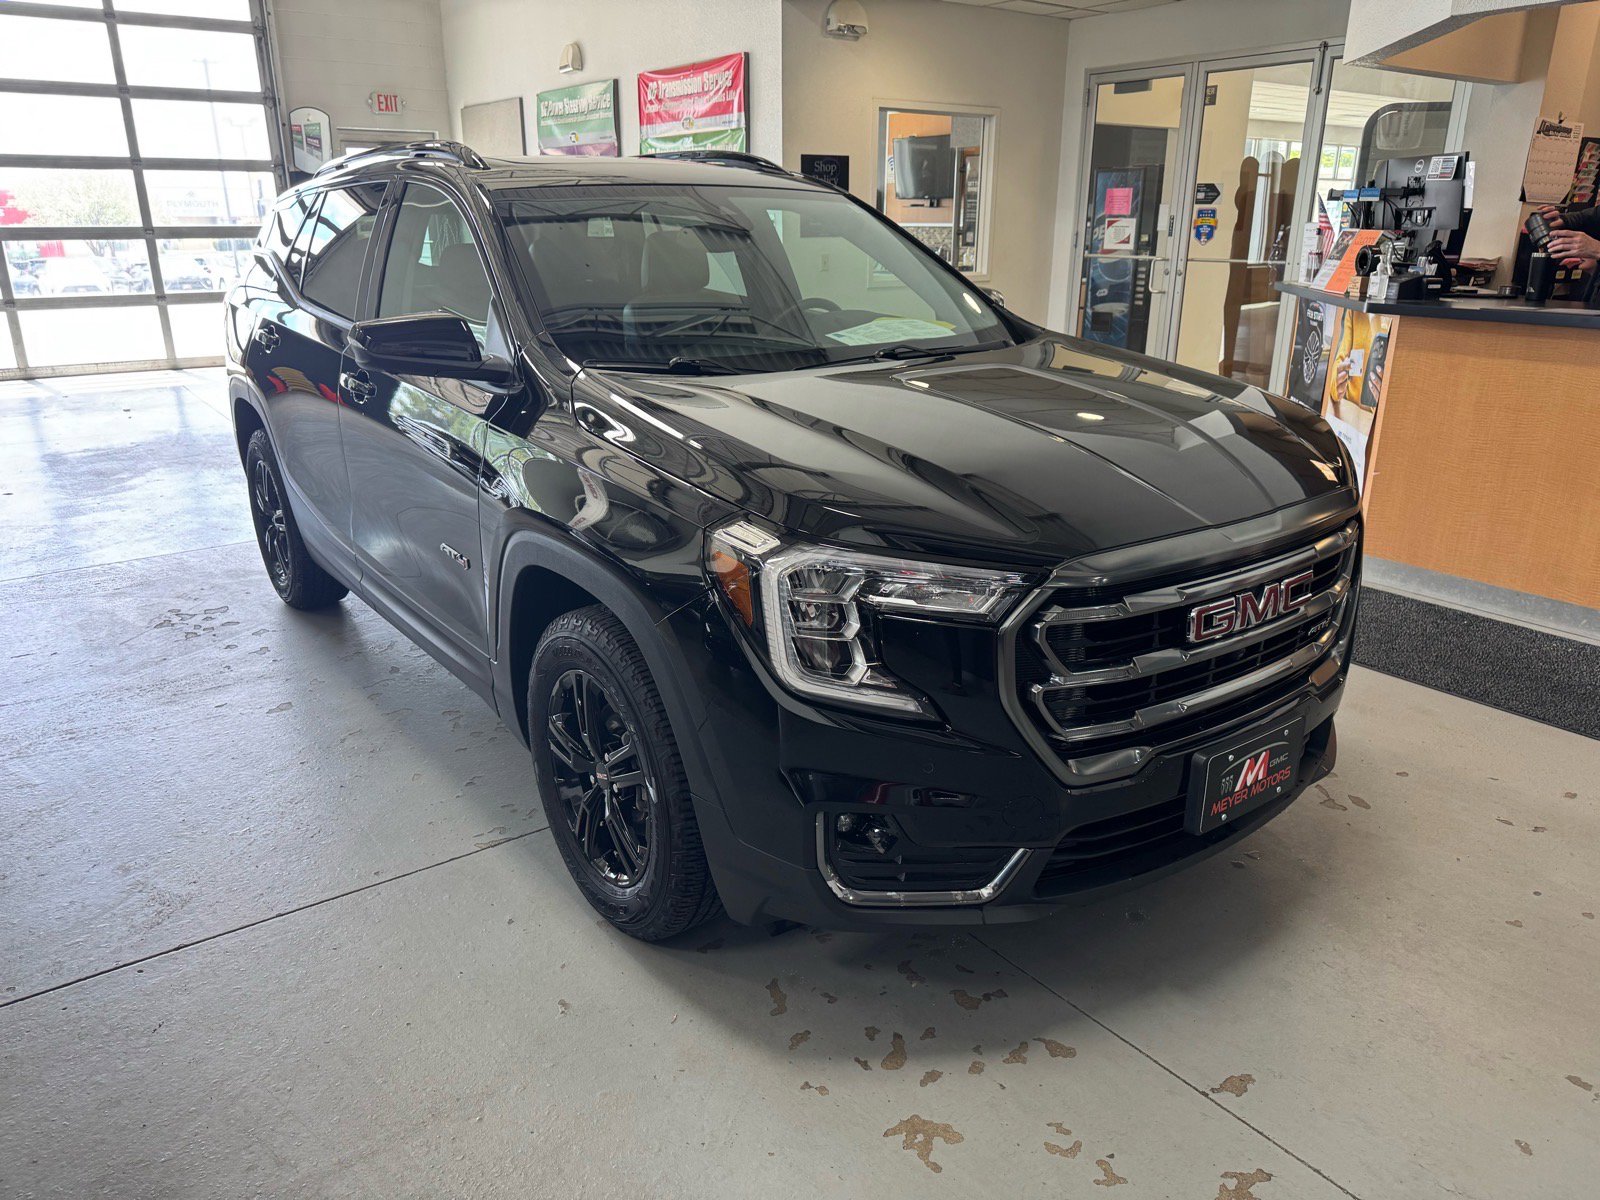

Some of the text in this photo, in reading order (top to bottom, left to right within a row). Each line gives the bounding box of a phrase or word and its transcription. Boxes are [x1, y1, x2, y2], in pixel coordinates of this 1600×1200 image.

[658, 75, 702, 98] Transmission
[703, 69, 733, 91] Service
[377, 94, 398, 112] EXIT
[548, 100, 564, 116] Power
[564, 95, 588, 116] Steering
[588, 93, 611, 111] Service
[814, 160, 837, 175] Shop
[166, 199, 219, 208] PLYMOUTH
[1187, 570, 1314, 643] GMC
[1269, 752, 1289, 767] GMC
[1210, 765, 1292, 817] MEYER MOTORS
